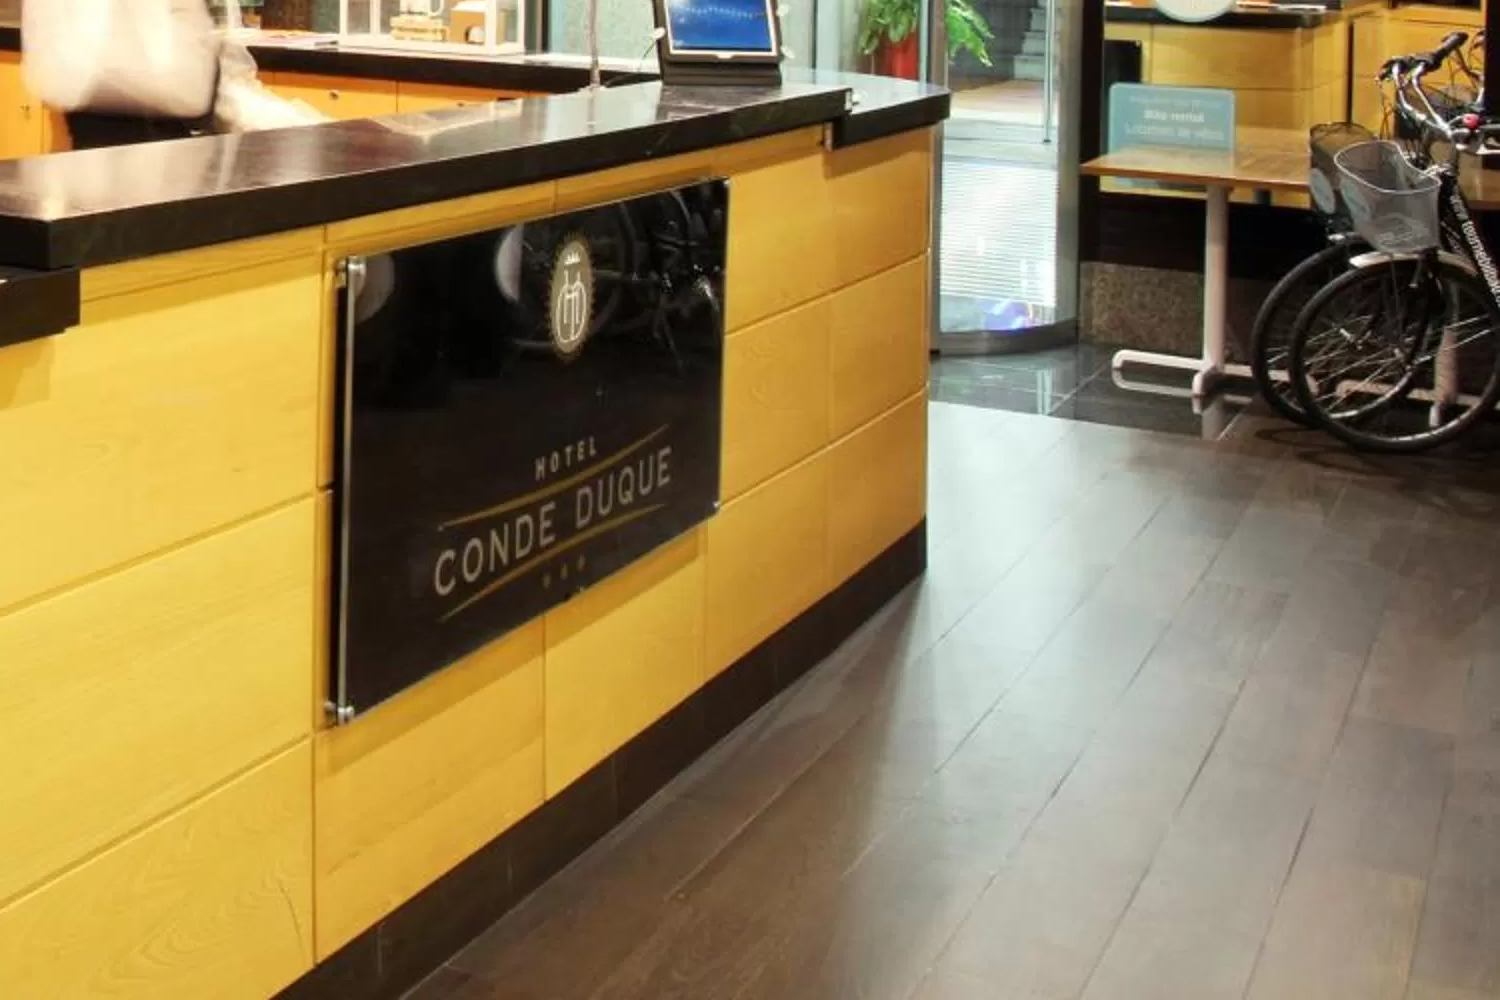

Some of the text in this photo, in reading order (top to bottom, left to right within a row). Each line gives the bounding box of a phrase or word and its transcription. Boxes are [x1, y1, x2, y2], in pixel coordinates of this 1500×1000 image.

[534, 436, 597, 481] HOTEL
[434, 446, 673, 596] CONDE DUQUE
